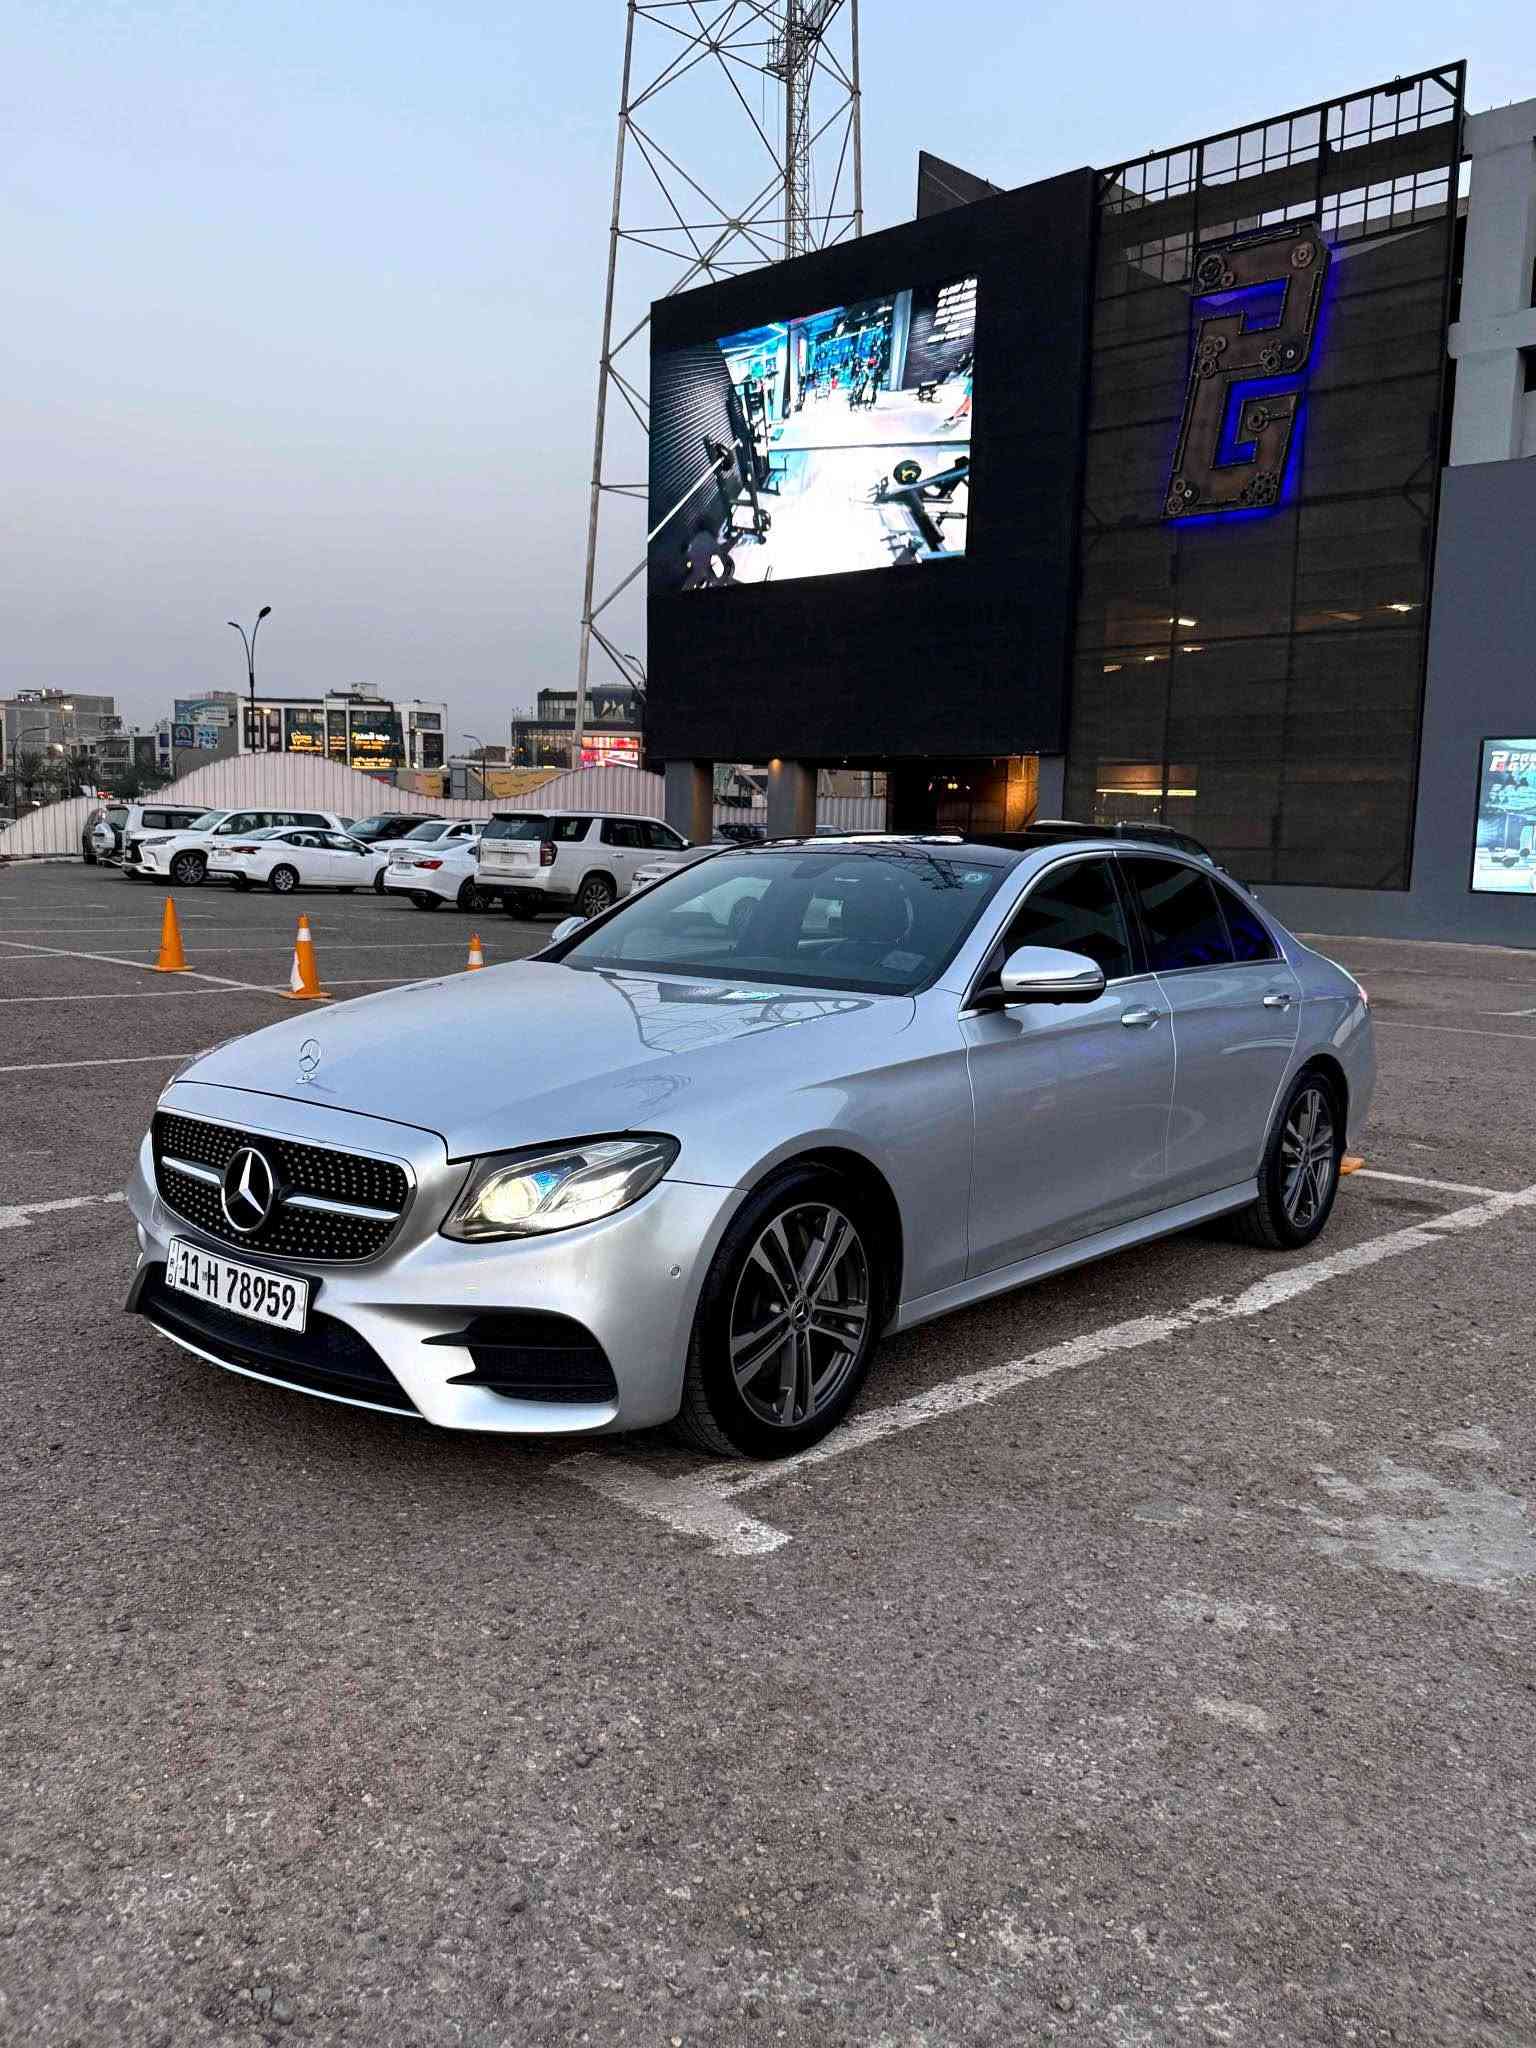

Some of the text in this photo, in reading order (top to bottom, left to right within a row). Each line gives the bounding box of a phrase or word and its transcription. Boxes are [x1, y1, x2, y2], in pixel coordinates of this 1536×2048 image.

[180, 1251, 296, 1320] 11 H 78959
